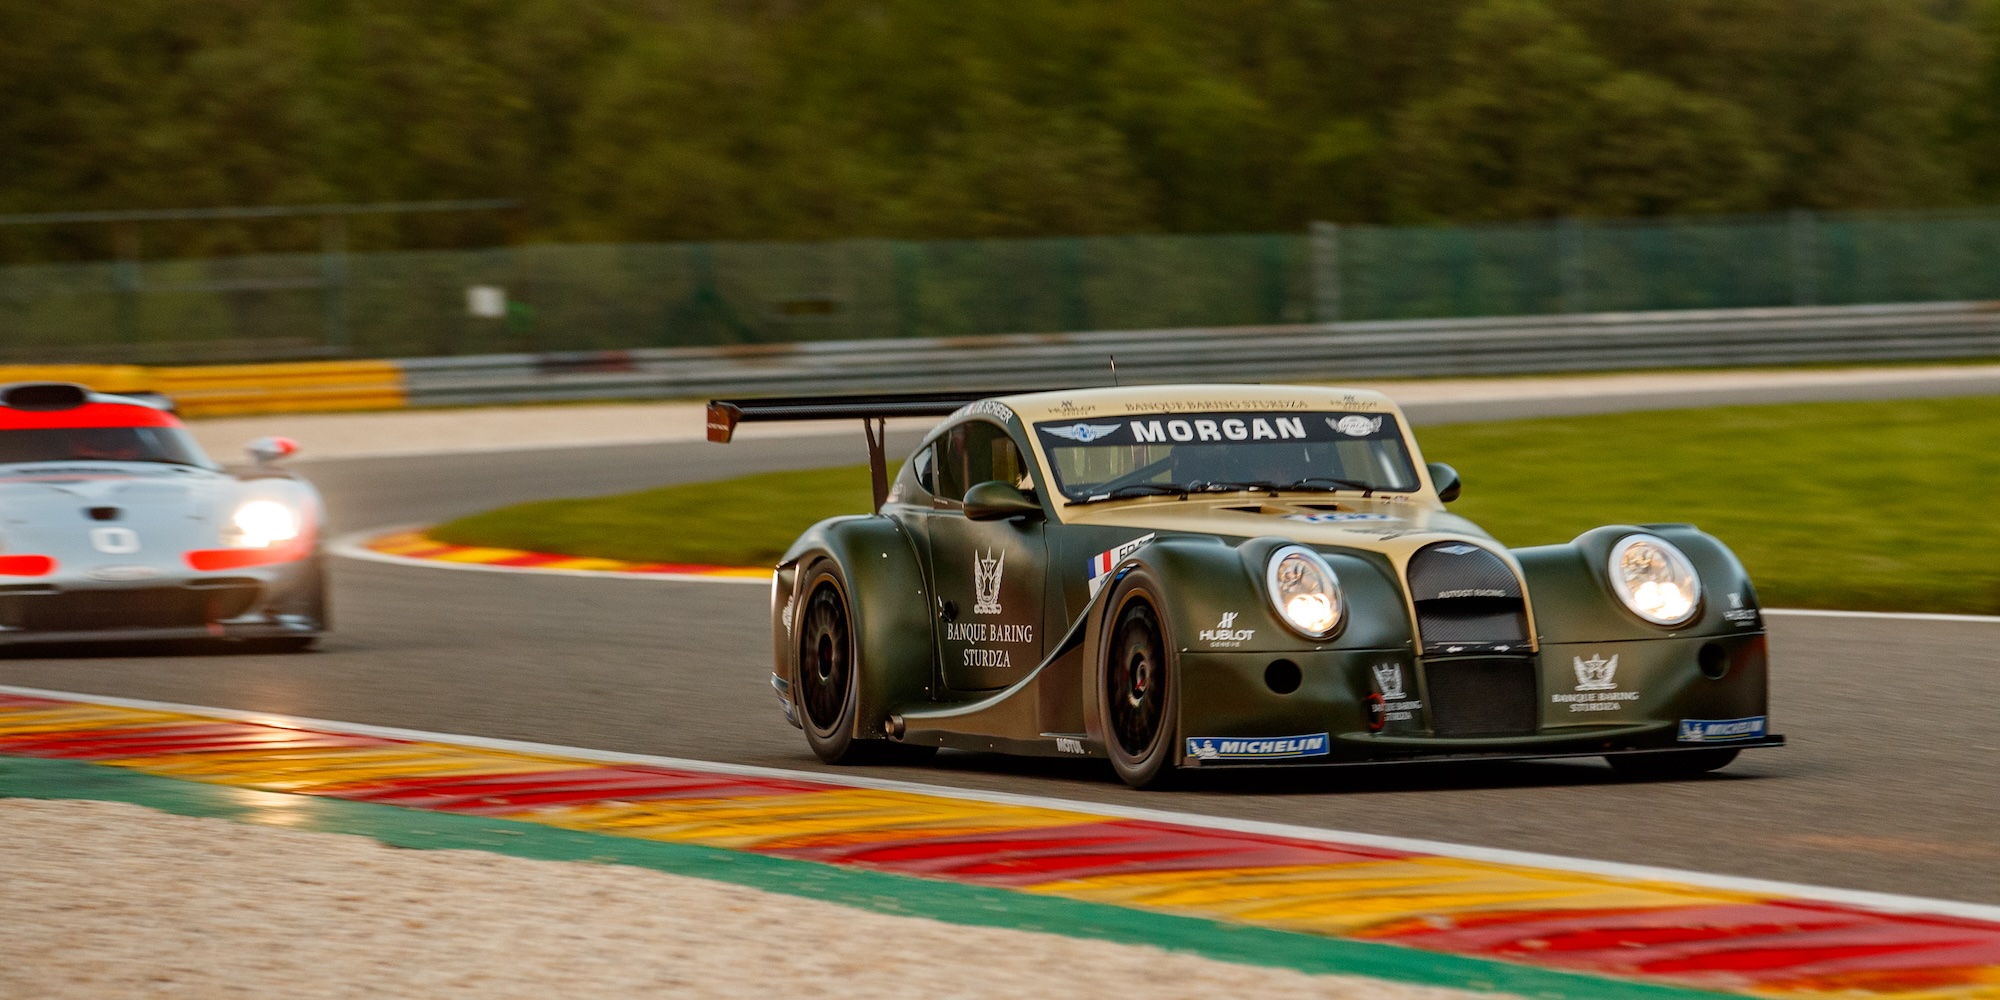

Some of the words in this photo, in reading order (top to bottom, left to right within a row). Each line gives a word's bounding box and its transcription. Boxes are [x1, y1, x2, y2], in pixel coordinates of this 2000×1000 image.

[1130, 417, 1307, 443] MORGAN
[91, 527, 139, 554] 0
[947, 623, 987, 645] BANQUE
[990, 624, 1033, 643] BARING
[1199, 629, 1255, 641] HUBLOT
[963, 648, 1011, 667] STURDZA
[1551, 693, 1597, 703] BANQUE
[1598, 691, 1640, 701] BARING
[1056, 737, 1085, 755] MOTUL
[1220, 737, 1324, 753] MICHELIN
